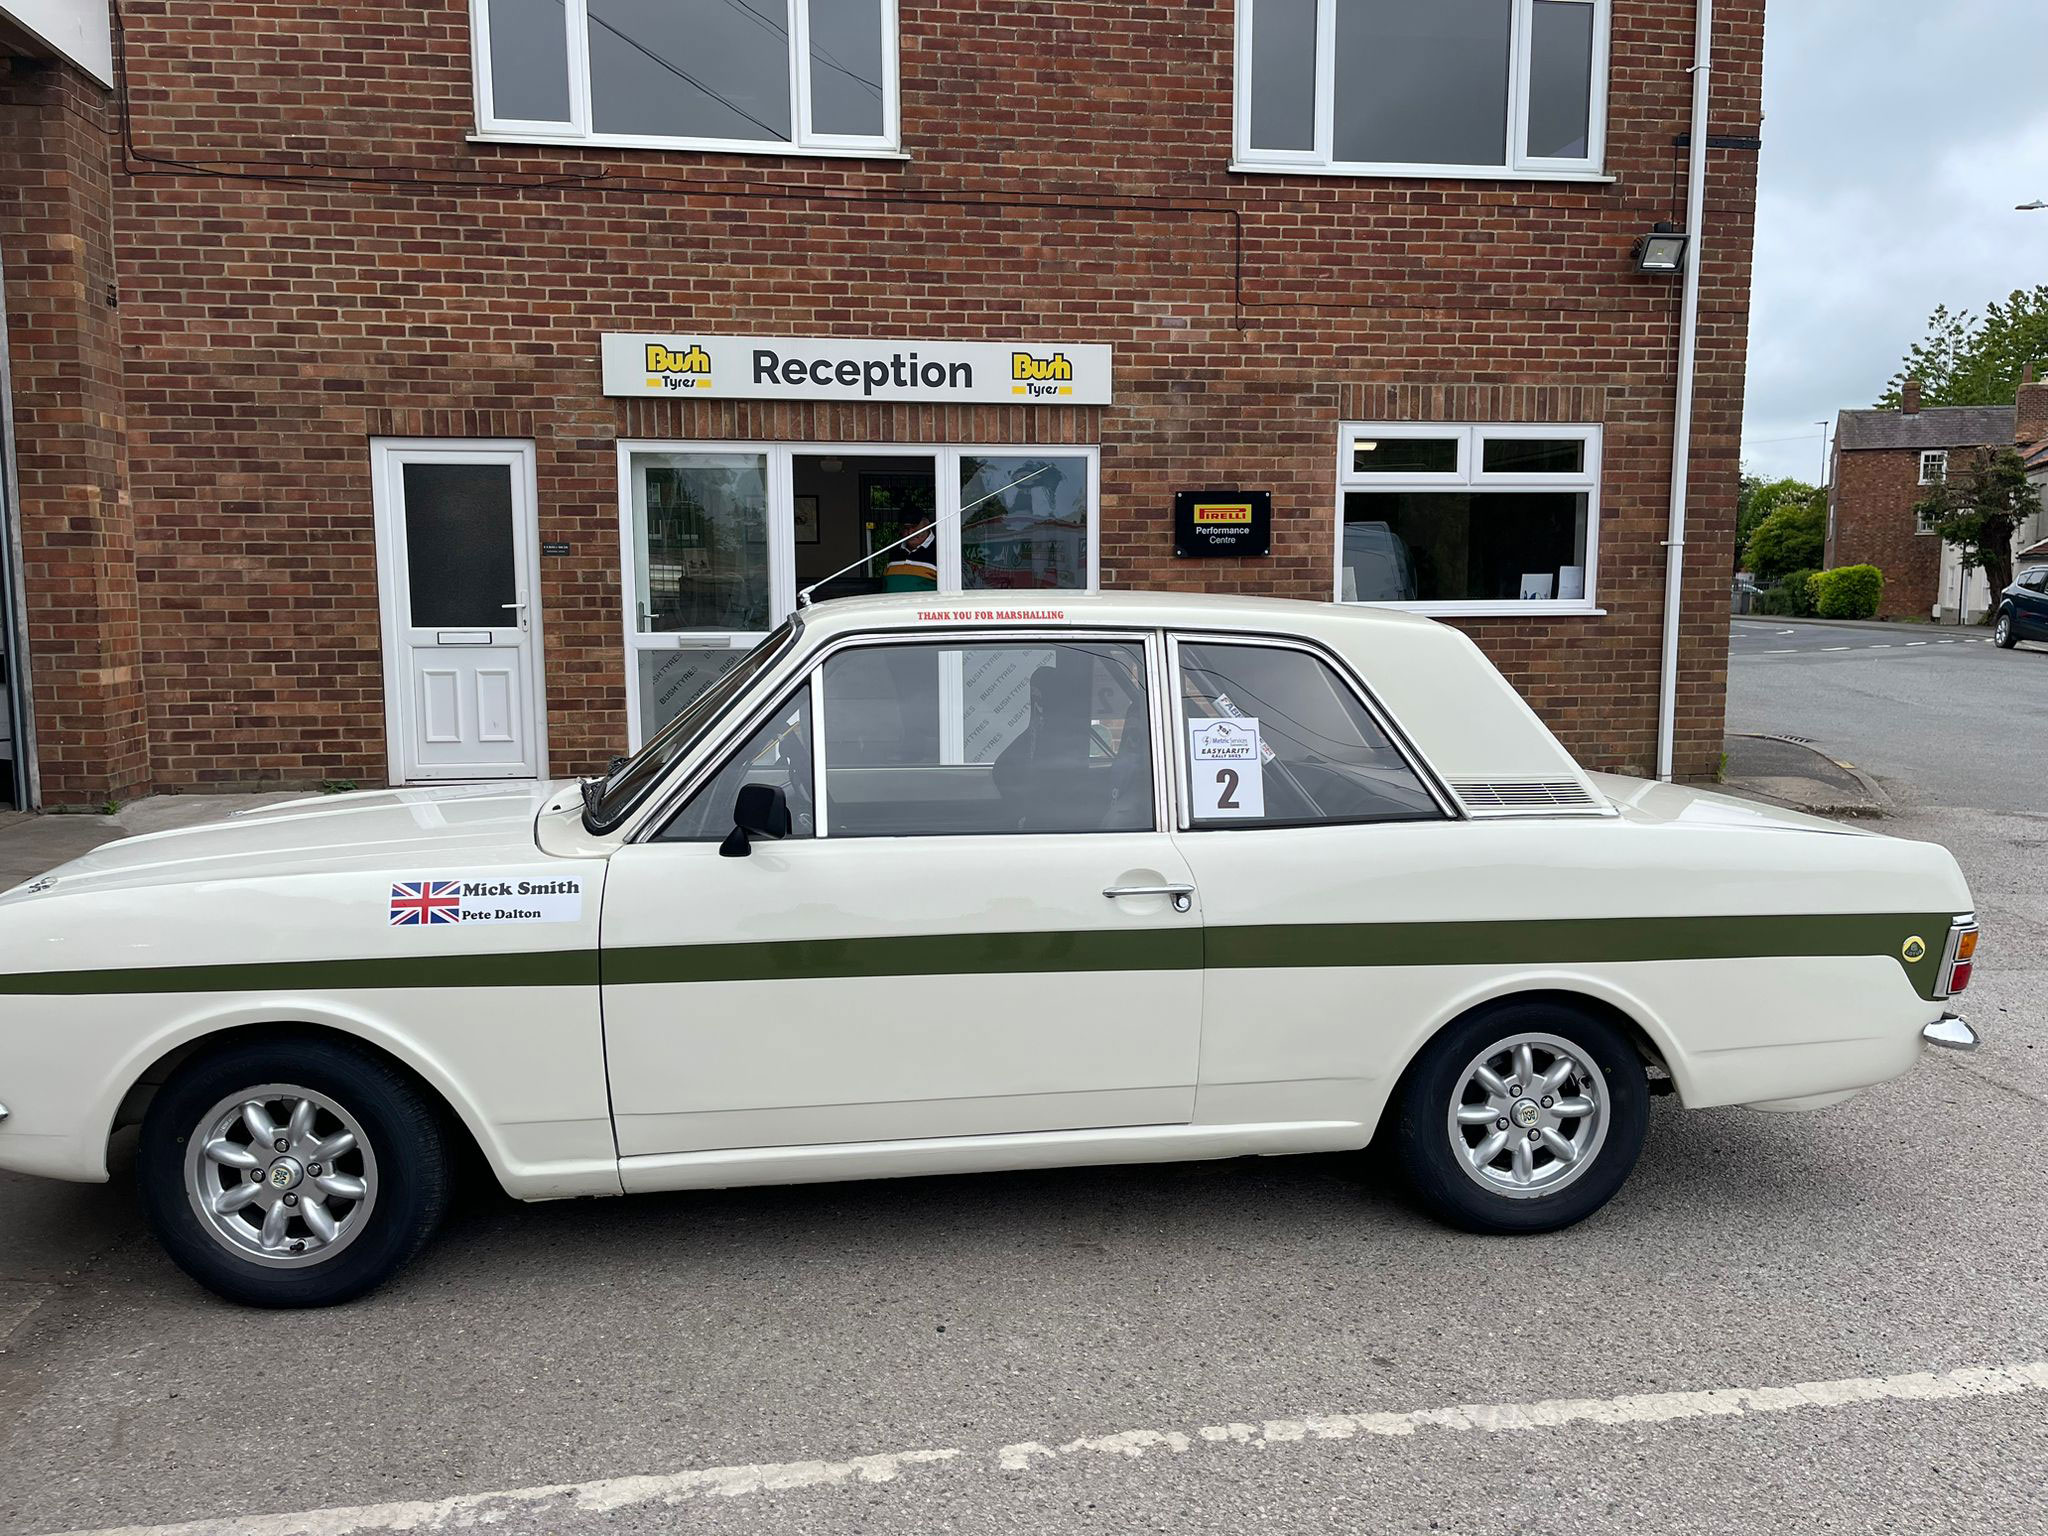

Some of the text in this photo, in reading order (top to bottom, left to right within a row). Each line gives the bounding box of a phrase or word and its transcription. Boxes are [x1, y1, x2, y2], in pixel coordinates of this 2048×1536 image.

[645, 344, 711, 373] Bush
[753, 350, 973, 396] Reception
[1012, 352, 1072, 381] Bush
[662, 376, 696, 390] Tyres
[1027, 383, 1058, 397] Tyres
[1199, 508, 1247, 520] PIRELLI
[1196, 526, 1250, 535] Performance
[1209, 536, 1236, 544] Centre
[917, 610, 1064, 621] THANK YOU FOR MARSHALLING
[1216, 769, 1239, 809] 2
[462, 881, 579, 896] Mick Smith
[462, 909, 541, 920] Pete Dalton
